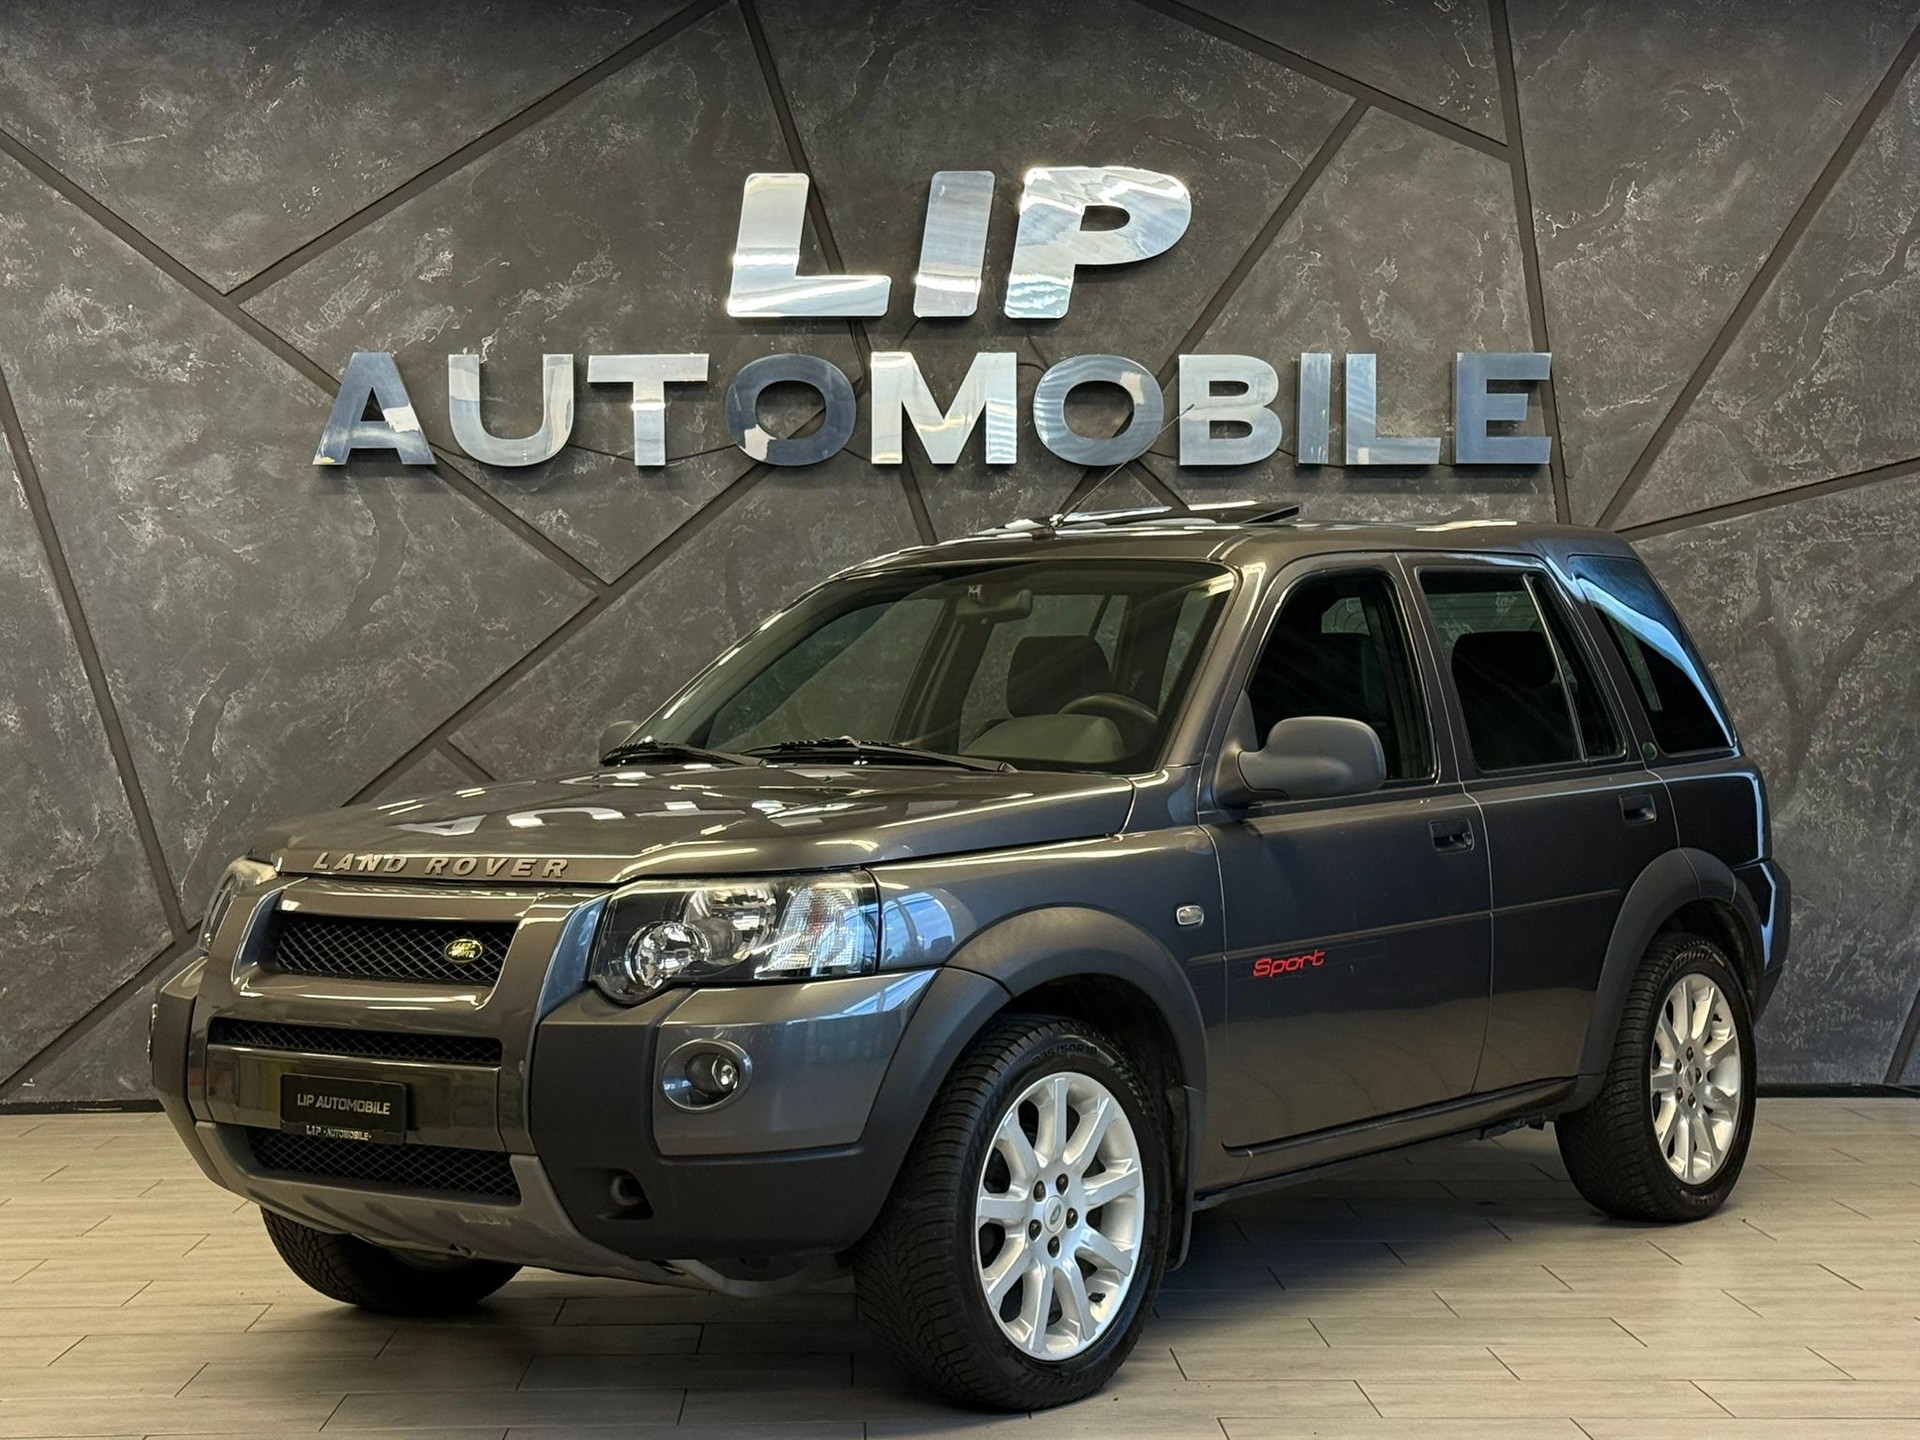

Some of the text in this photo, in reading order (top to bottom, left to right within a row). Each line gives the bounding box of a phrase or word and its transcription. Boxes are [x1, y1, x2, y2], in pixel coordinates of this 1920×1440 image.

[727, 166, 1192, 319] LIP
[312, 351, 1552, 467] AUTOMOBILE
[313, 852, 569, 878] LAND ROVER
[1253, 950, 1325, 977] Sport
[297, 1093, 391, 1116] LIP AUTOMOBILE
[306, 1124, 321, 1136] LIP
